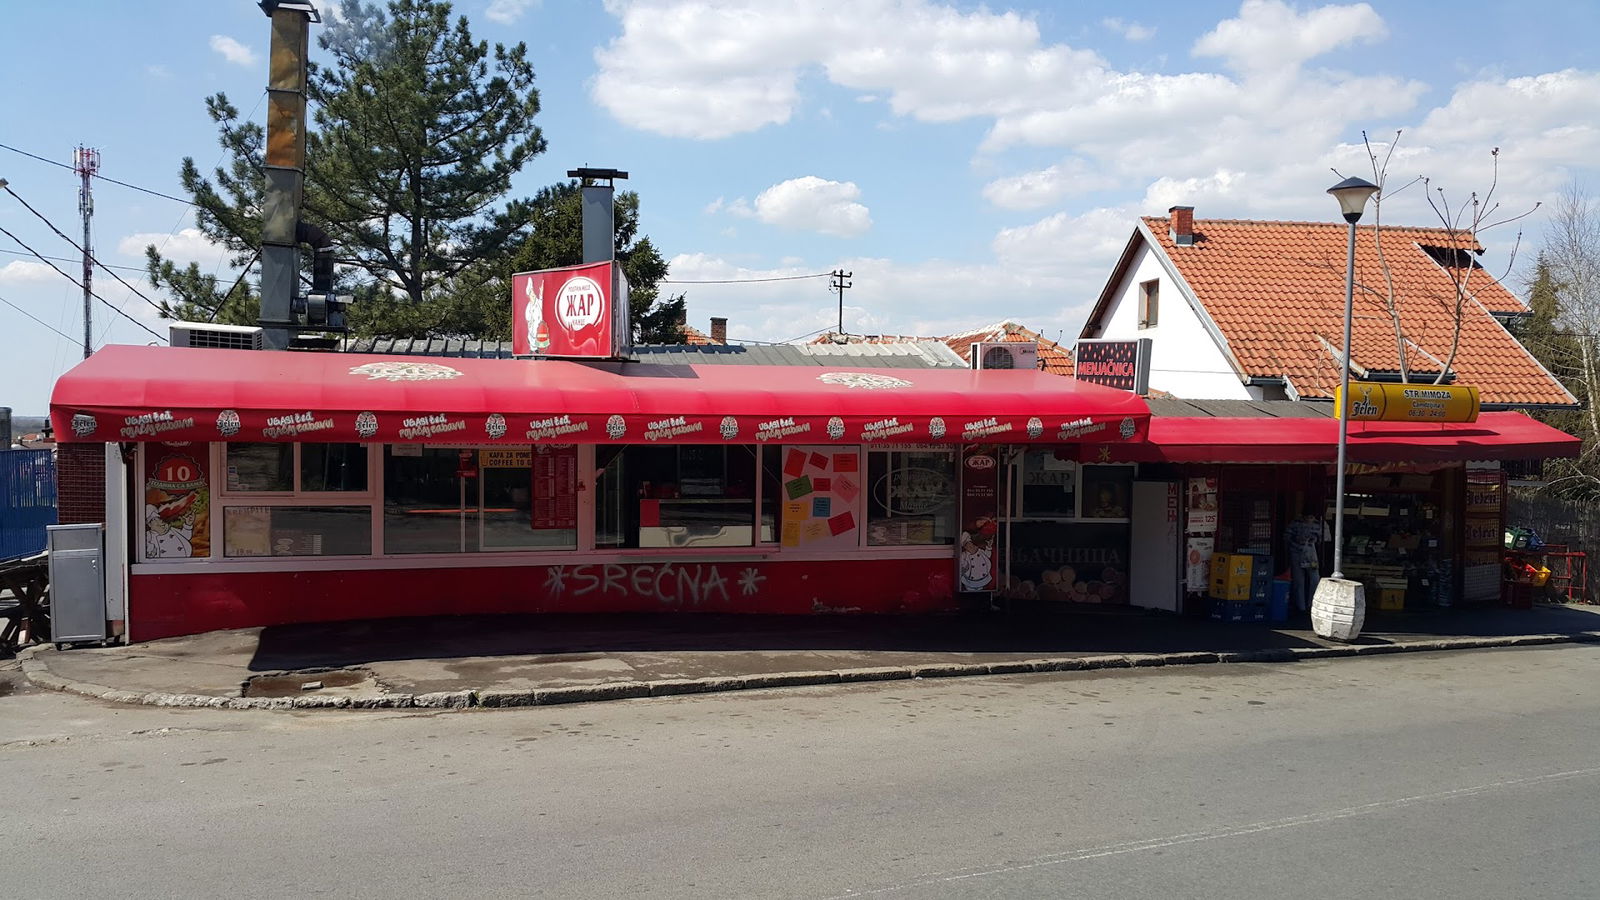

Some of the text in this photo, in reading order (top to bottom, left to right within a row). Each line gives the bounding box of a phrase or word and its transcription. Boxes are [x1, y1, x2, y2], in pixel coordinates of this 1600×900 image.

[566, 294, 593, 317] ЖАР
[1078, 359, 1134, 376] MENJAČNICA
[1351, 401, 1378, 416] Jelen
[216, 420, 240, 428] Jelen
[355, 421, 378, 429] Jelen
[485, 423, 507, 431] Jelen
[606, 424, 626, 432] Jelen
[166, 466, 191, 481] 10
[1027, 472, 1070, 485] ЖАР
[573, 562, 730, 605] SREČNA
